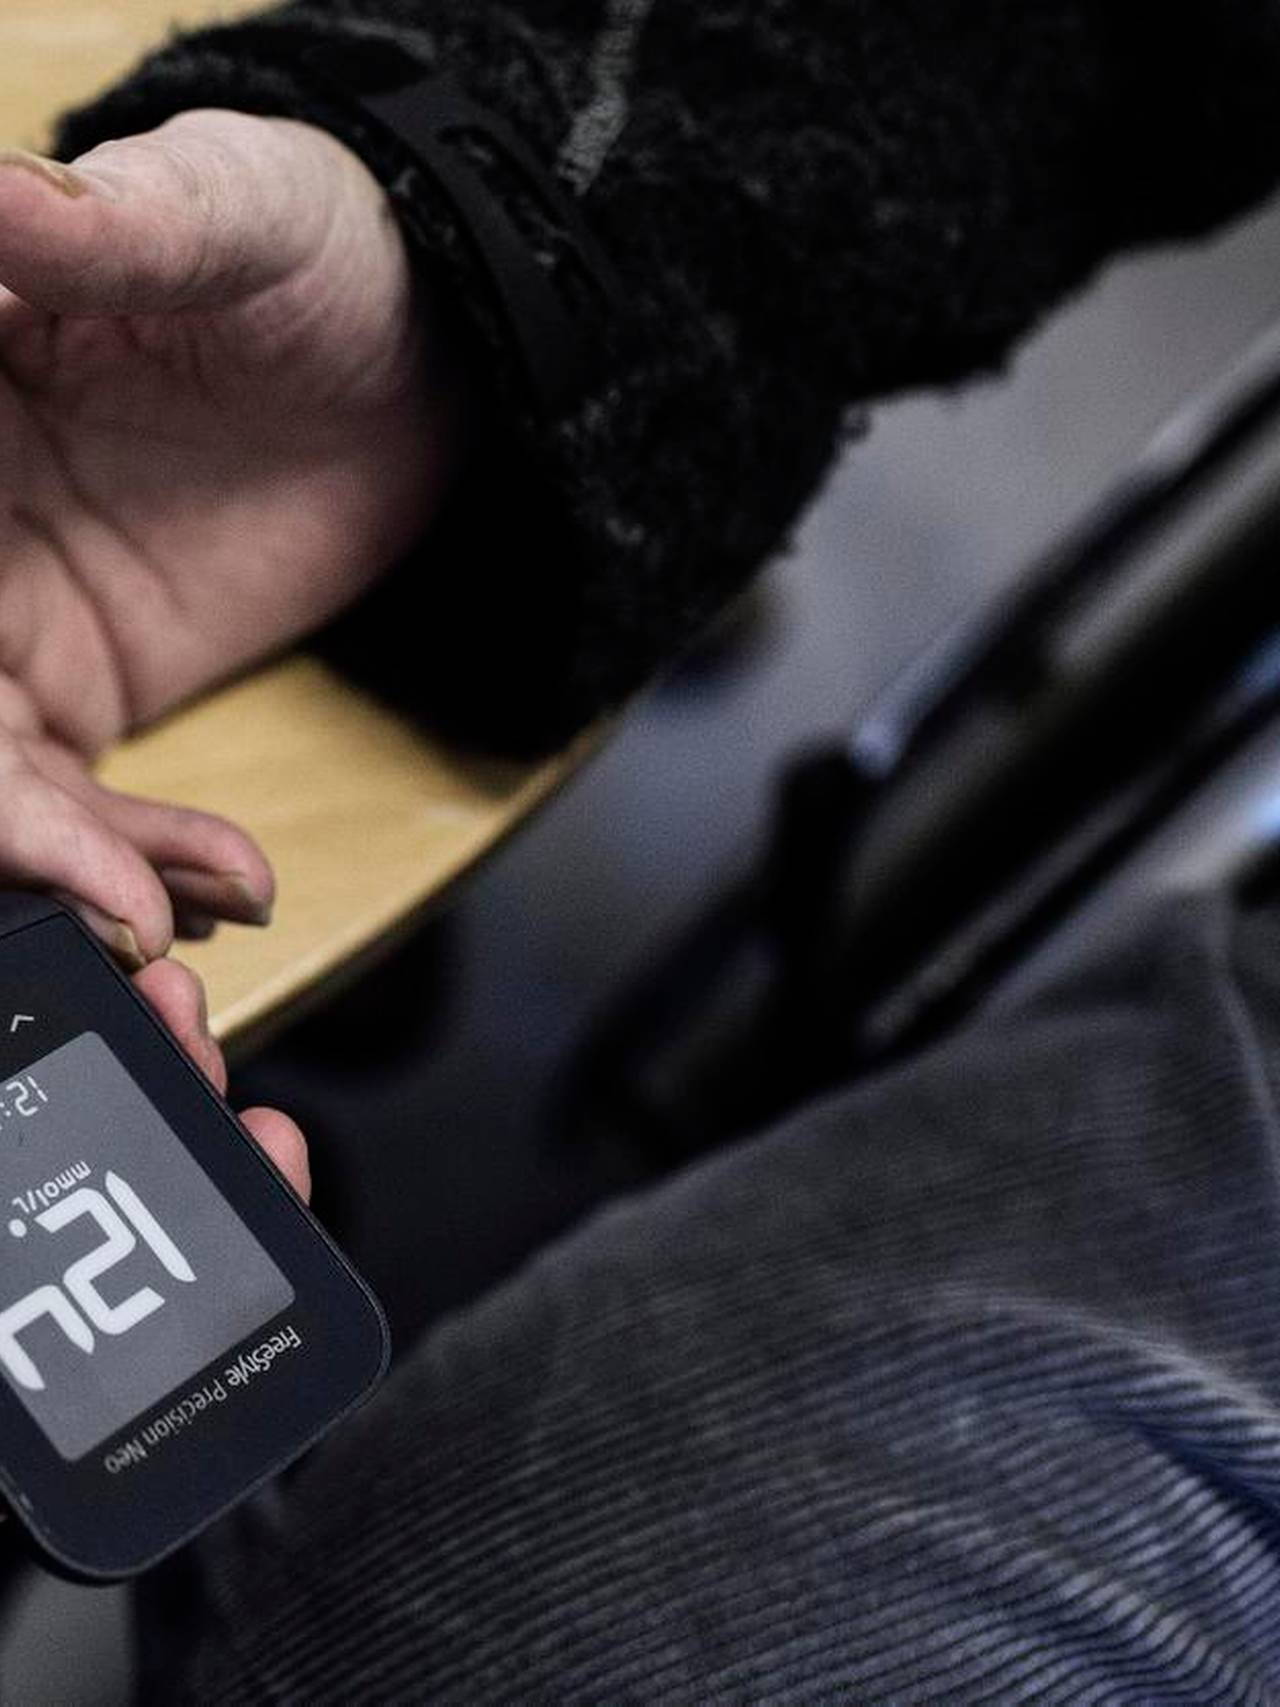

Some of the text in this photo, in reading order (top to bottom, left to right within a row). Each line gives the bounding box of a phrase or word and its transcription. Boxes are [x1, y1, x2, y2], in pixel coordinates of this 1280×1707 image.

[12, 1160, 91, 1213] mmol/L
[105, 1326, 302, 1474] FreeStyle Precision Neo
